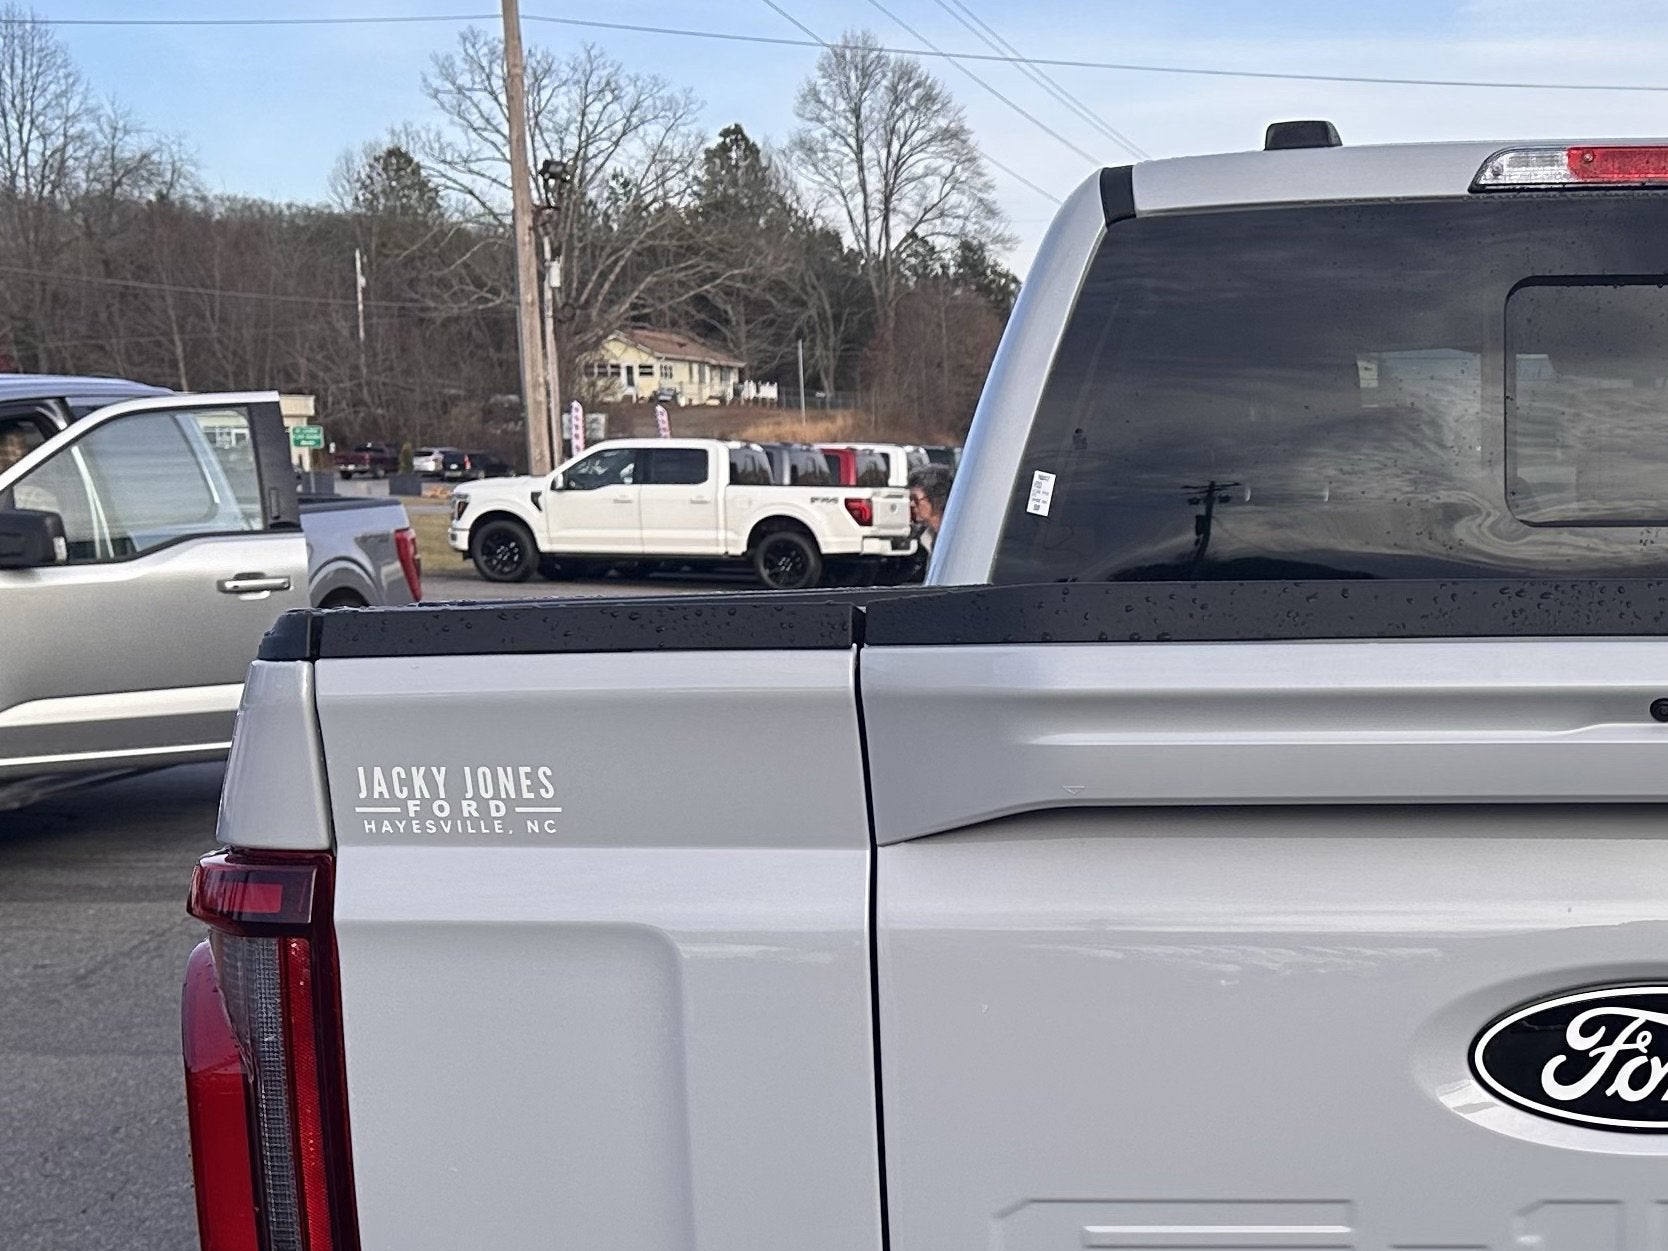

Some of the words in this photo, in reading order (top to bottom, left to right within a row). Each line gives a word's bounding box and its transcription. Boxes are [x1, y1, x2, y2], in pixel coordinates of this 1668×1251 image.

[357, 766, 447, 799] JACKY
[463, 766, 555, 799] JONES
[406, 799, 507, 818] FORD
[364, 819, 513, 834] HAYESVILLE,
[526, 819, 557, 834] NC
